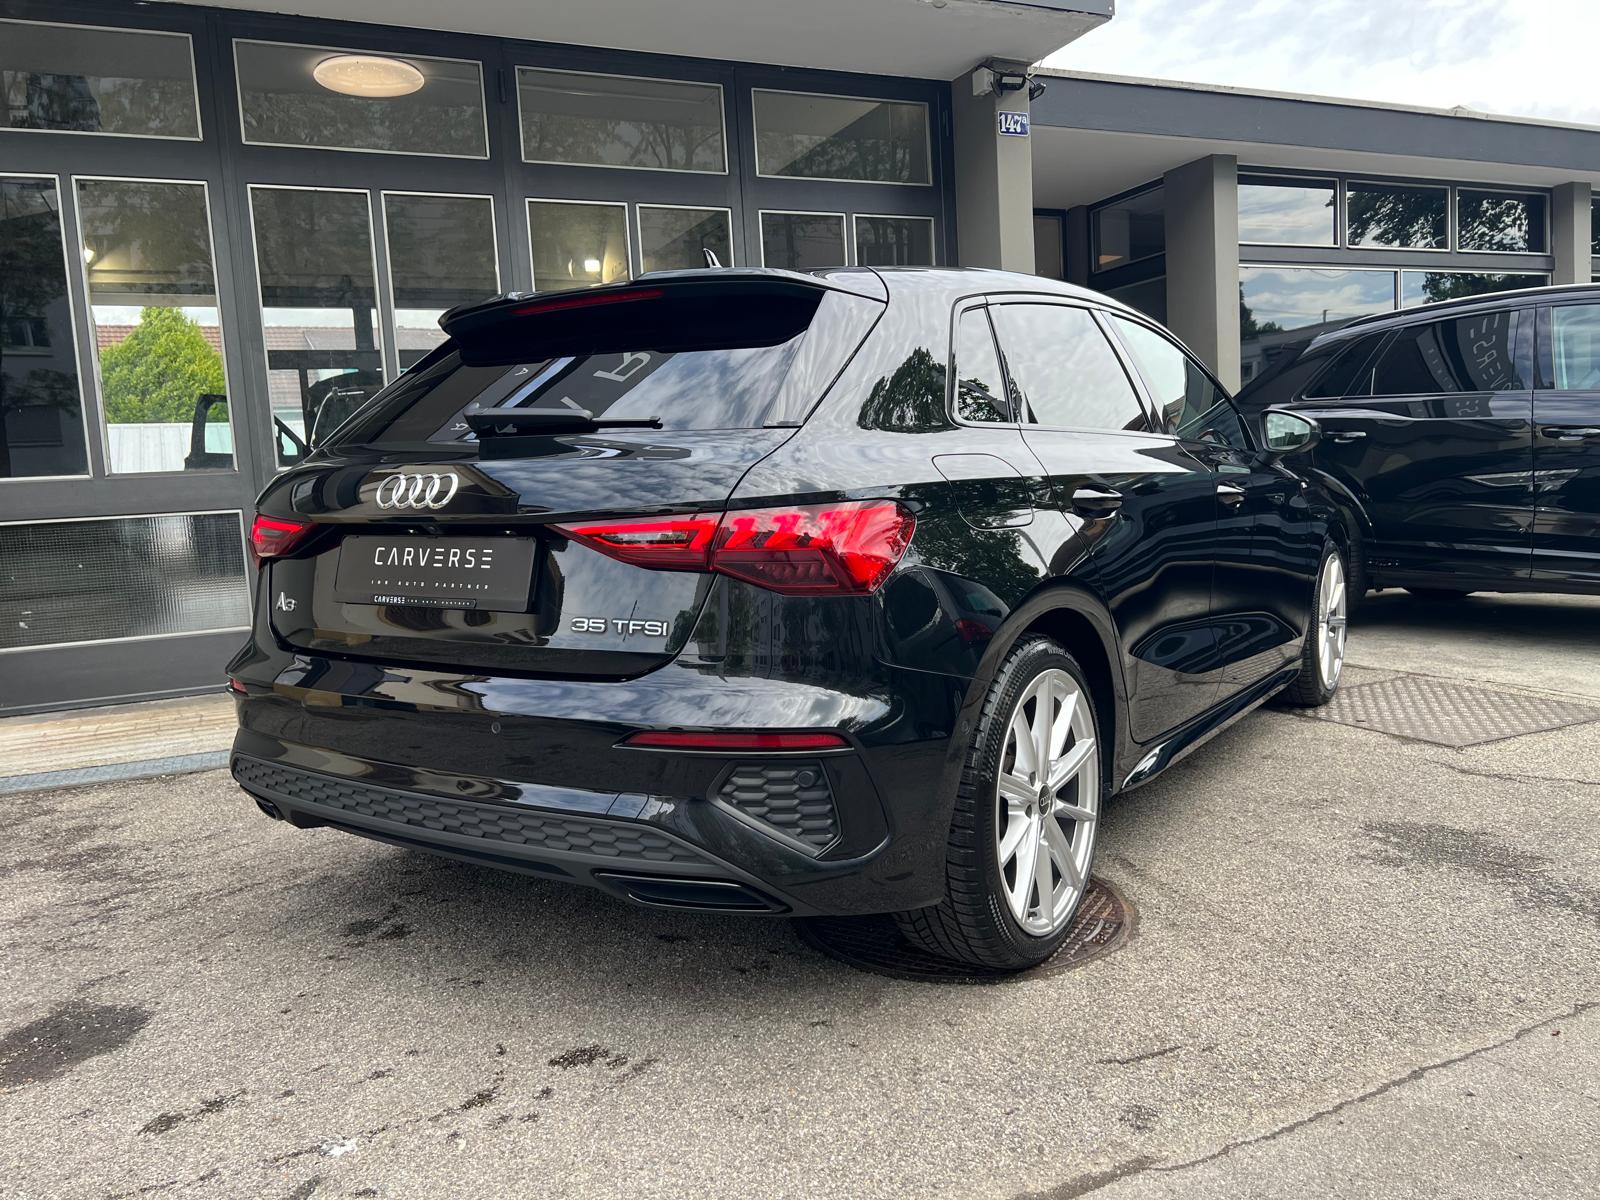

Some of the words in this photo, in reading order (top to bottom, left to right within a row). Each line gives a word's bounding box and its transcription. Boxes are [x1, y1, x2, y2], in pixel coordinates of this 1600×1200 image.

[374, 547, 493, 569] CARVERSE
[275, 591, 297, 611] A3
[374, 595, 405, 604] CARVERSE
[571, 617, 606, 633] 35
[612, 619, 668, 636] TFSI
